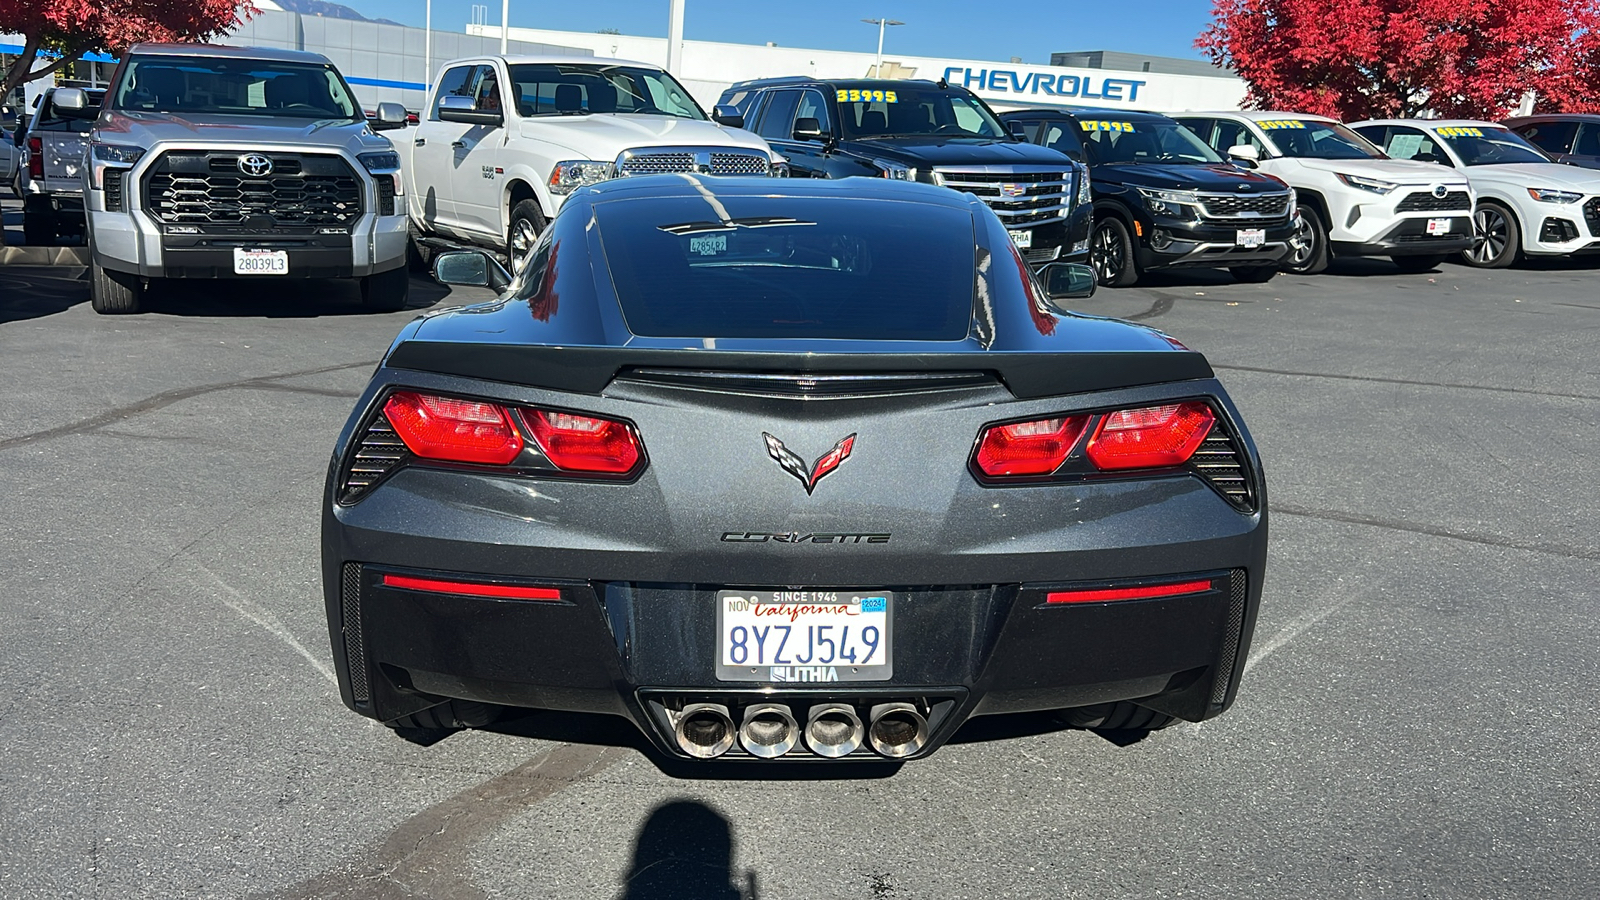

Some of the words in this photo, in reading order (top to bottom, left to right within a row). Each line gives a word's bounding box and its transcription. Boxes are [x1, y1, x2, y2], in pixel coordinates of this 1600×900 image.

[944, 67, 1146, 102] CHEVROLET
[837, 89, 897, 103] 33995
[1080, 120, 1135, 133] 17995
[1256, 120, 1305, 130] 30995
[239, 259, 284, 270] 28039L3
[720, 531, 892, 544] CORVETTE
[773, 591, 808, 602] SINCE
[811, 591, 838, 602] 1946
[728, 600, 750, 613] NOV
[754, 603, 860, 623] California
[729, 625, 880, 665] 8YZJ549
[785, 666, 839, 683] LITHIA
